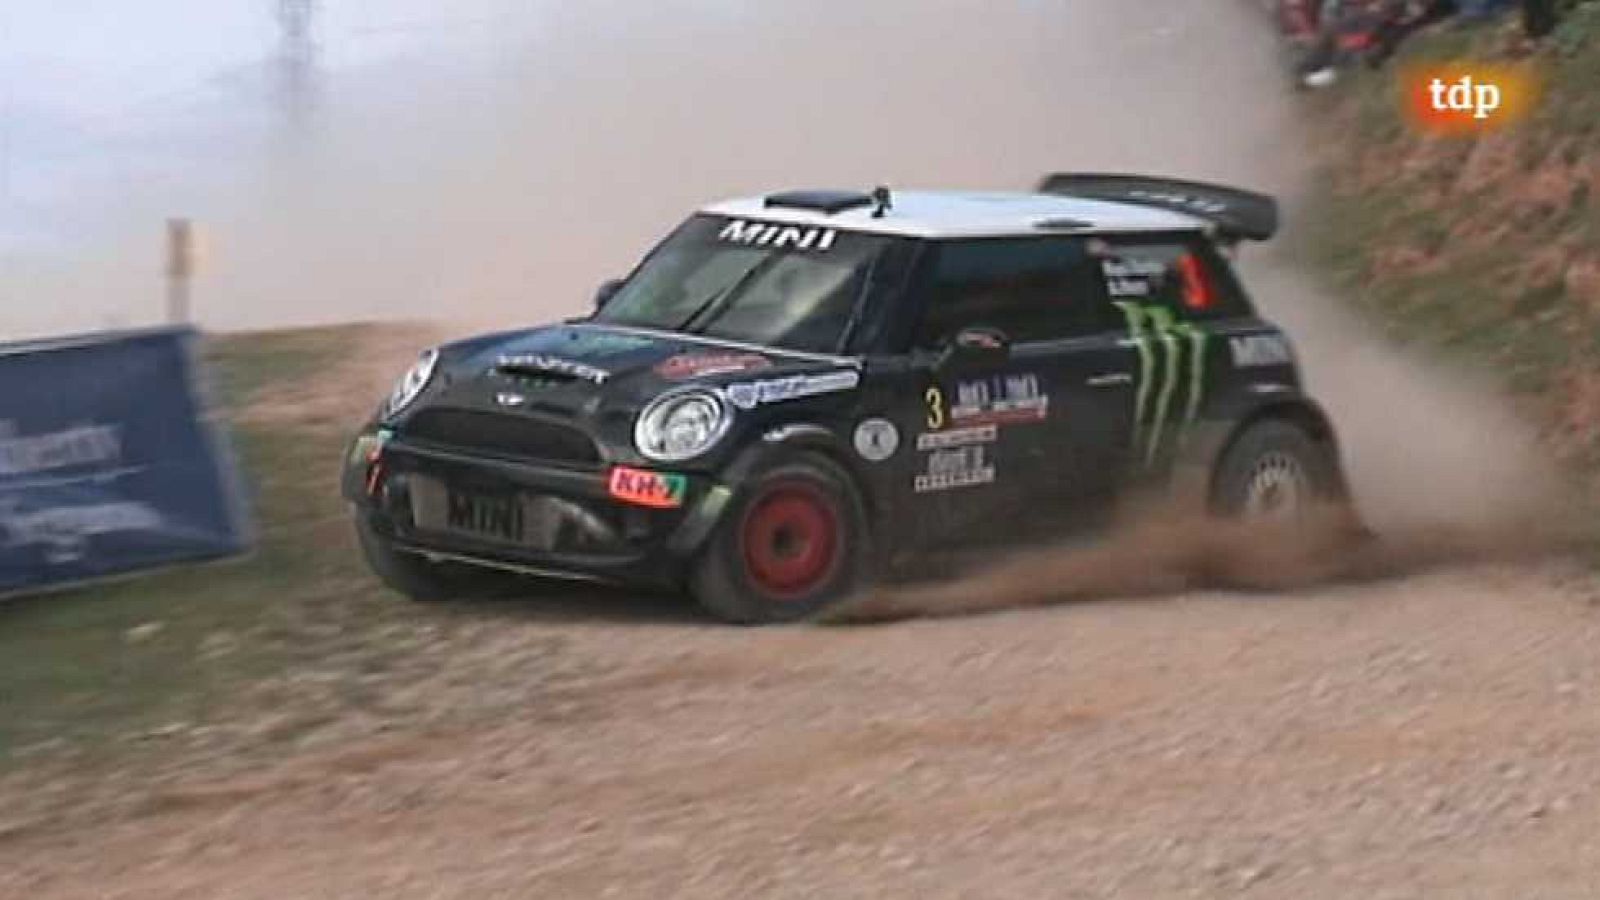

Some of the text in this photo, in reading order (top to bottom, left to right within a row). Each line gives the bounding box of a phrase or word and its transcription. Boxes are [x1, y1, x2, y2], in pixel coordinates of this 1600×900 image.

[718, 219, 837, 248] MINI
[925, 386, 944, 429] 3
[615, 470, 683, 503] KH-7
[446, 491, 525, 543] MINI
